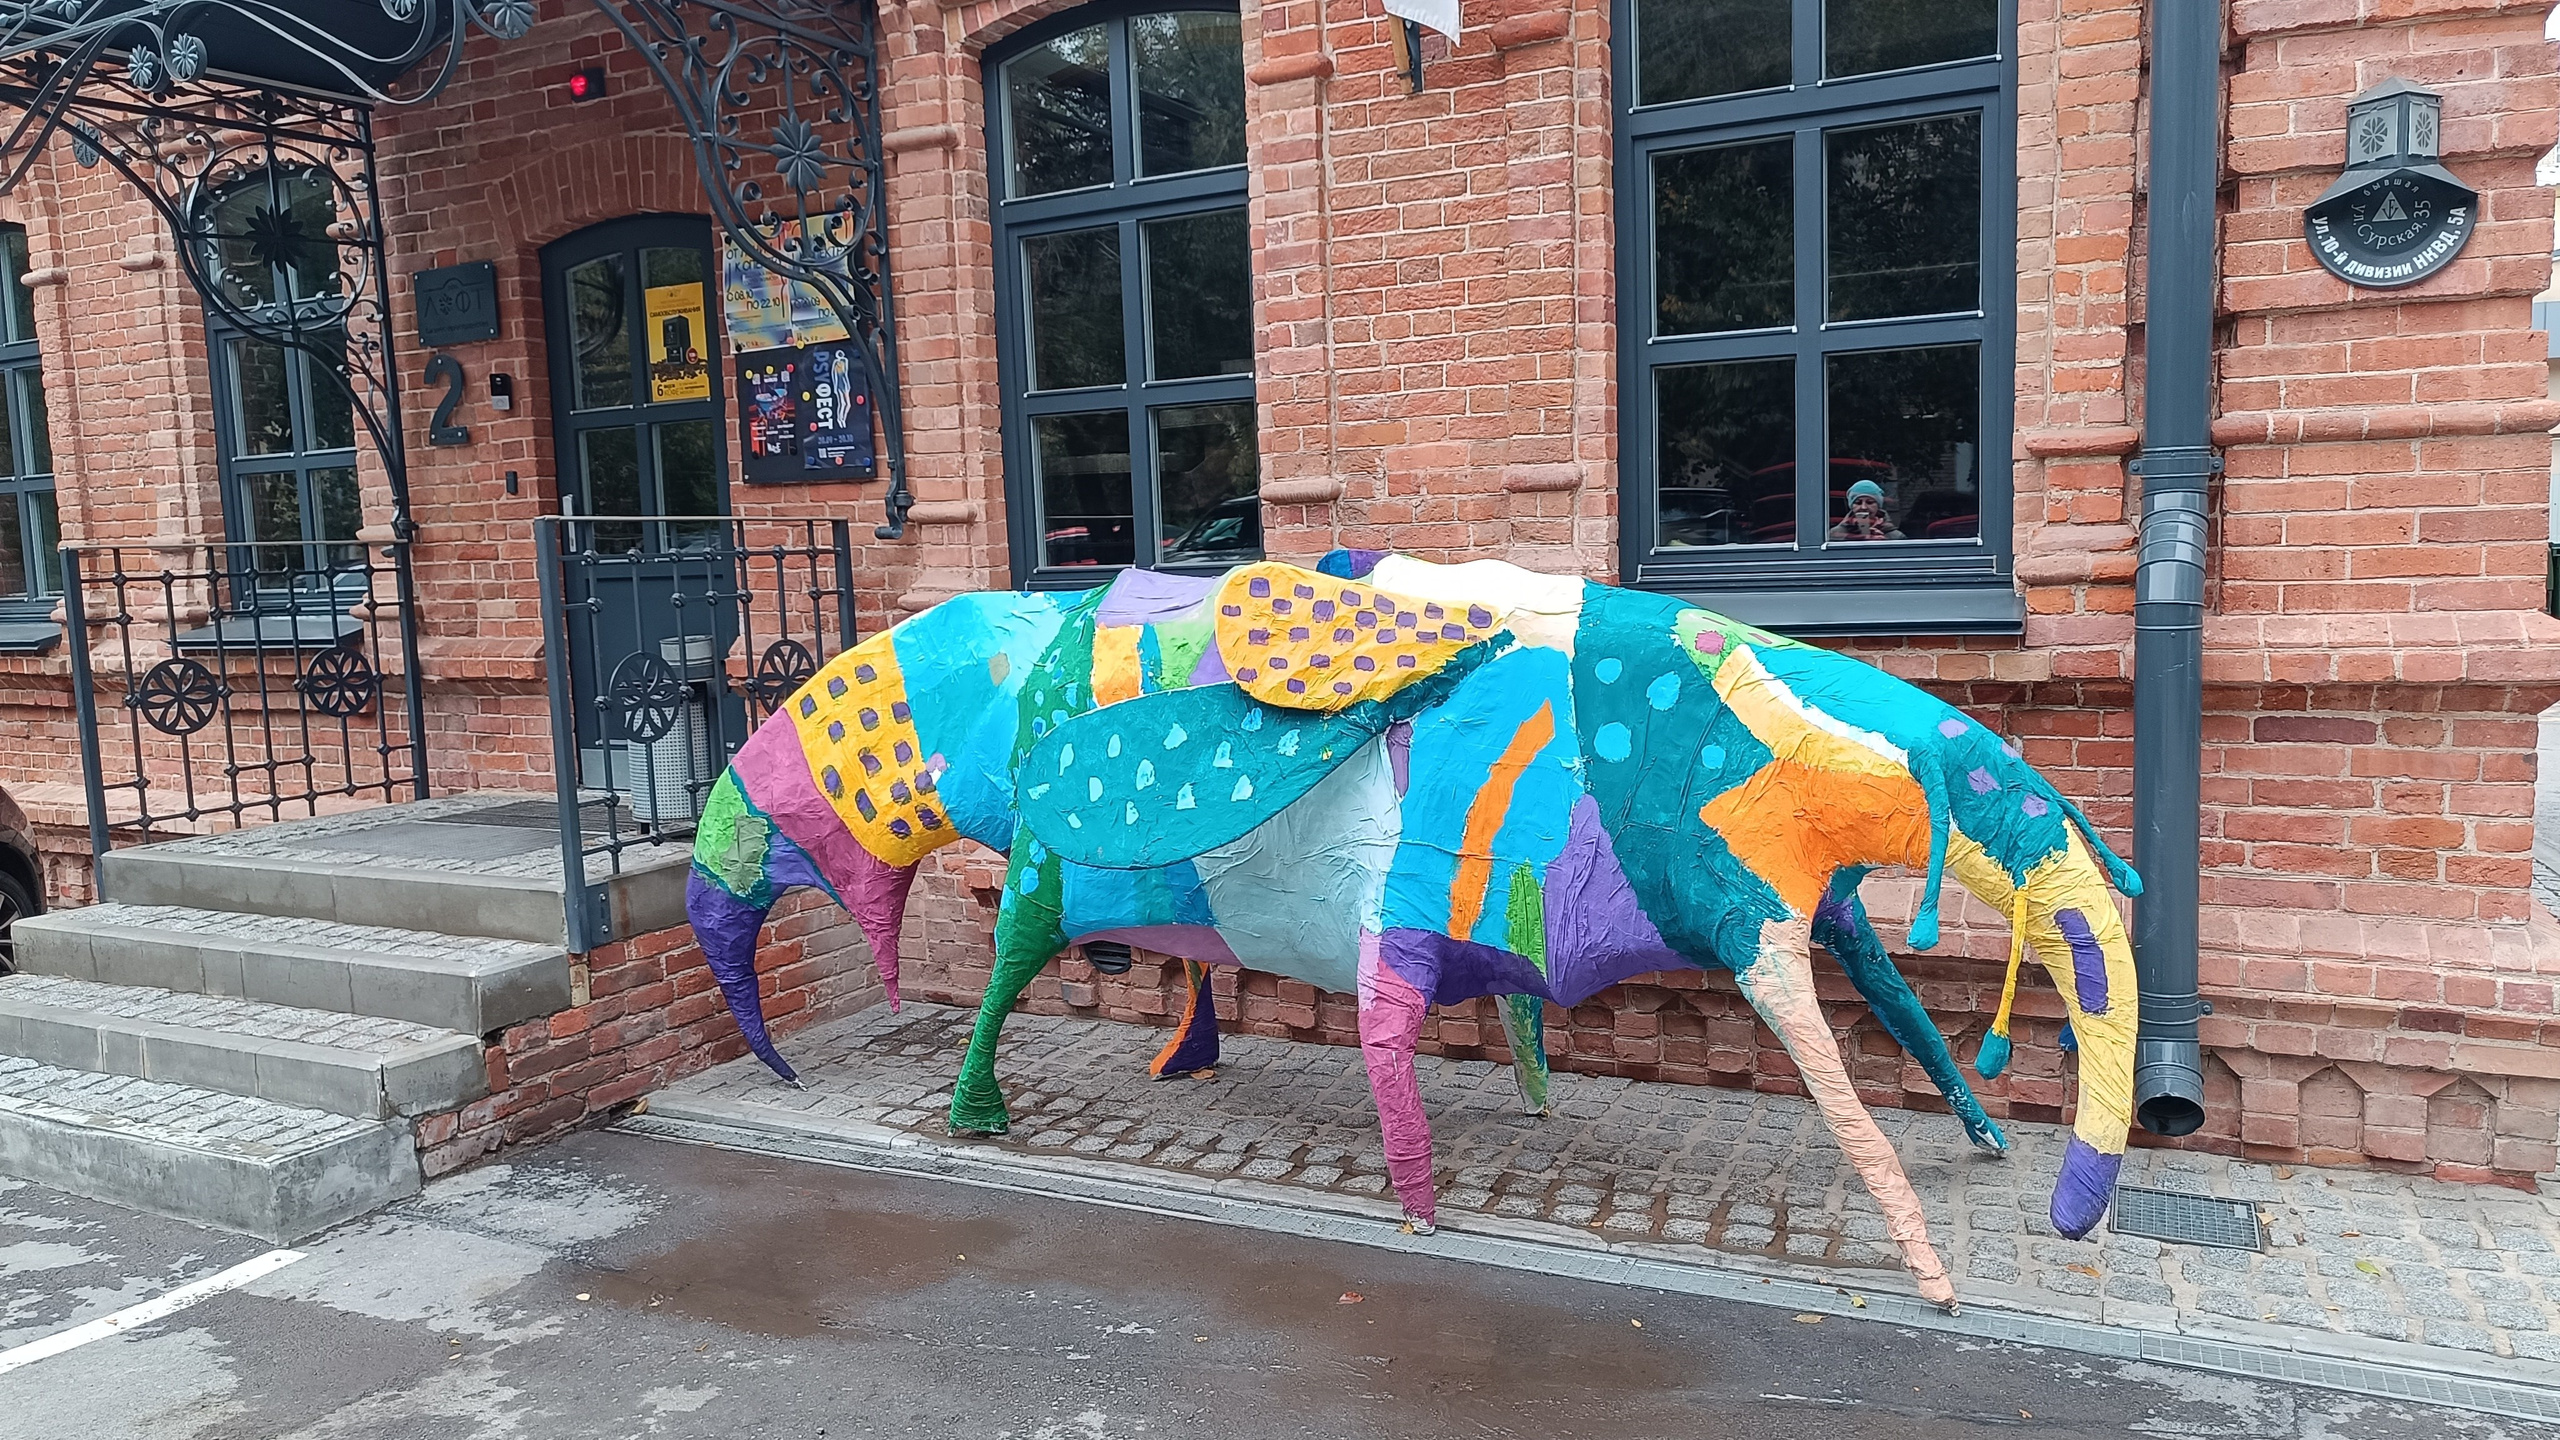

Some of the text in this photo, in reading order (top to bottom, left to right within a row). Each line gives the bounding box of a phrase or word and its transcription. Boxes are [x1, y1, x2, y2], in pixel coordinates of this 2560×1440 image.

[2363, 178, 2419, 196] бывшая
[2413, 200, 2432, 219] 35
[2447, 206, 2468, 226] 5А
[424, 353, 467, 446] 2
[657, 384, 664, 397] 6
